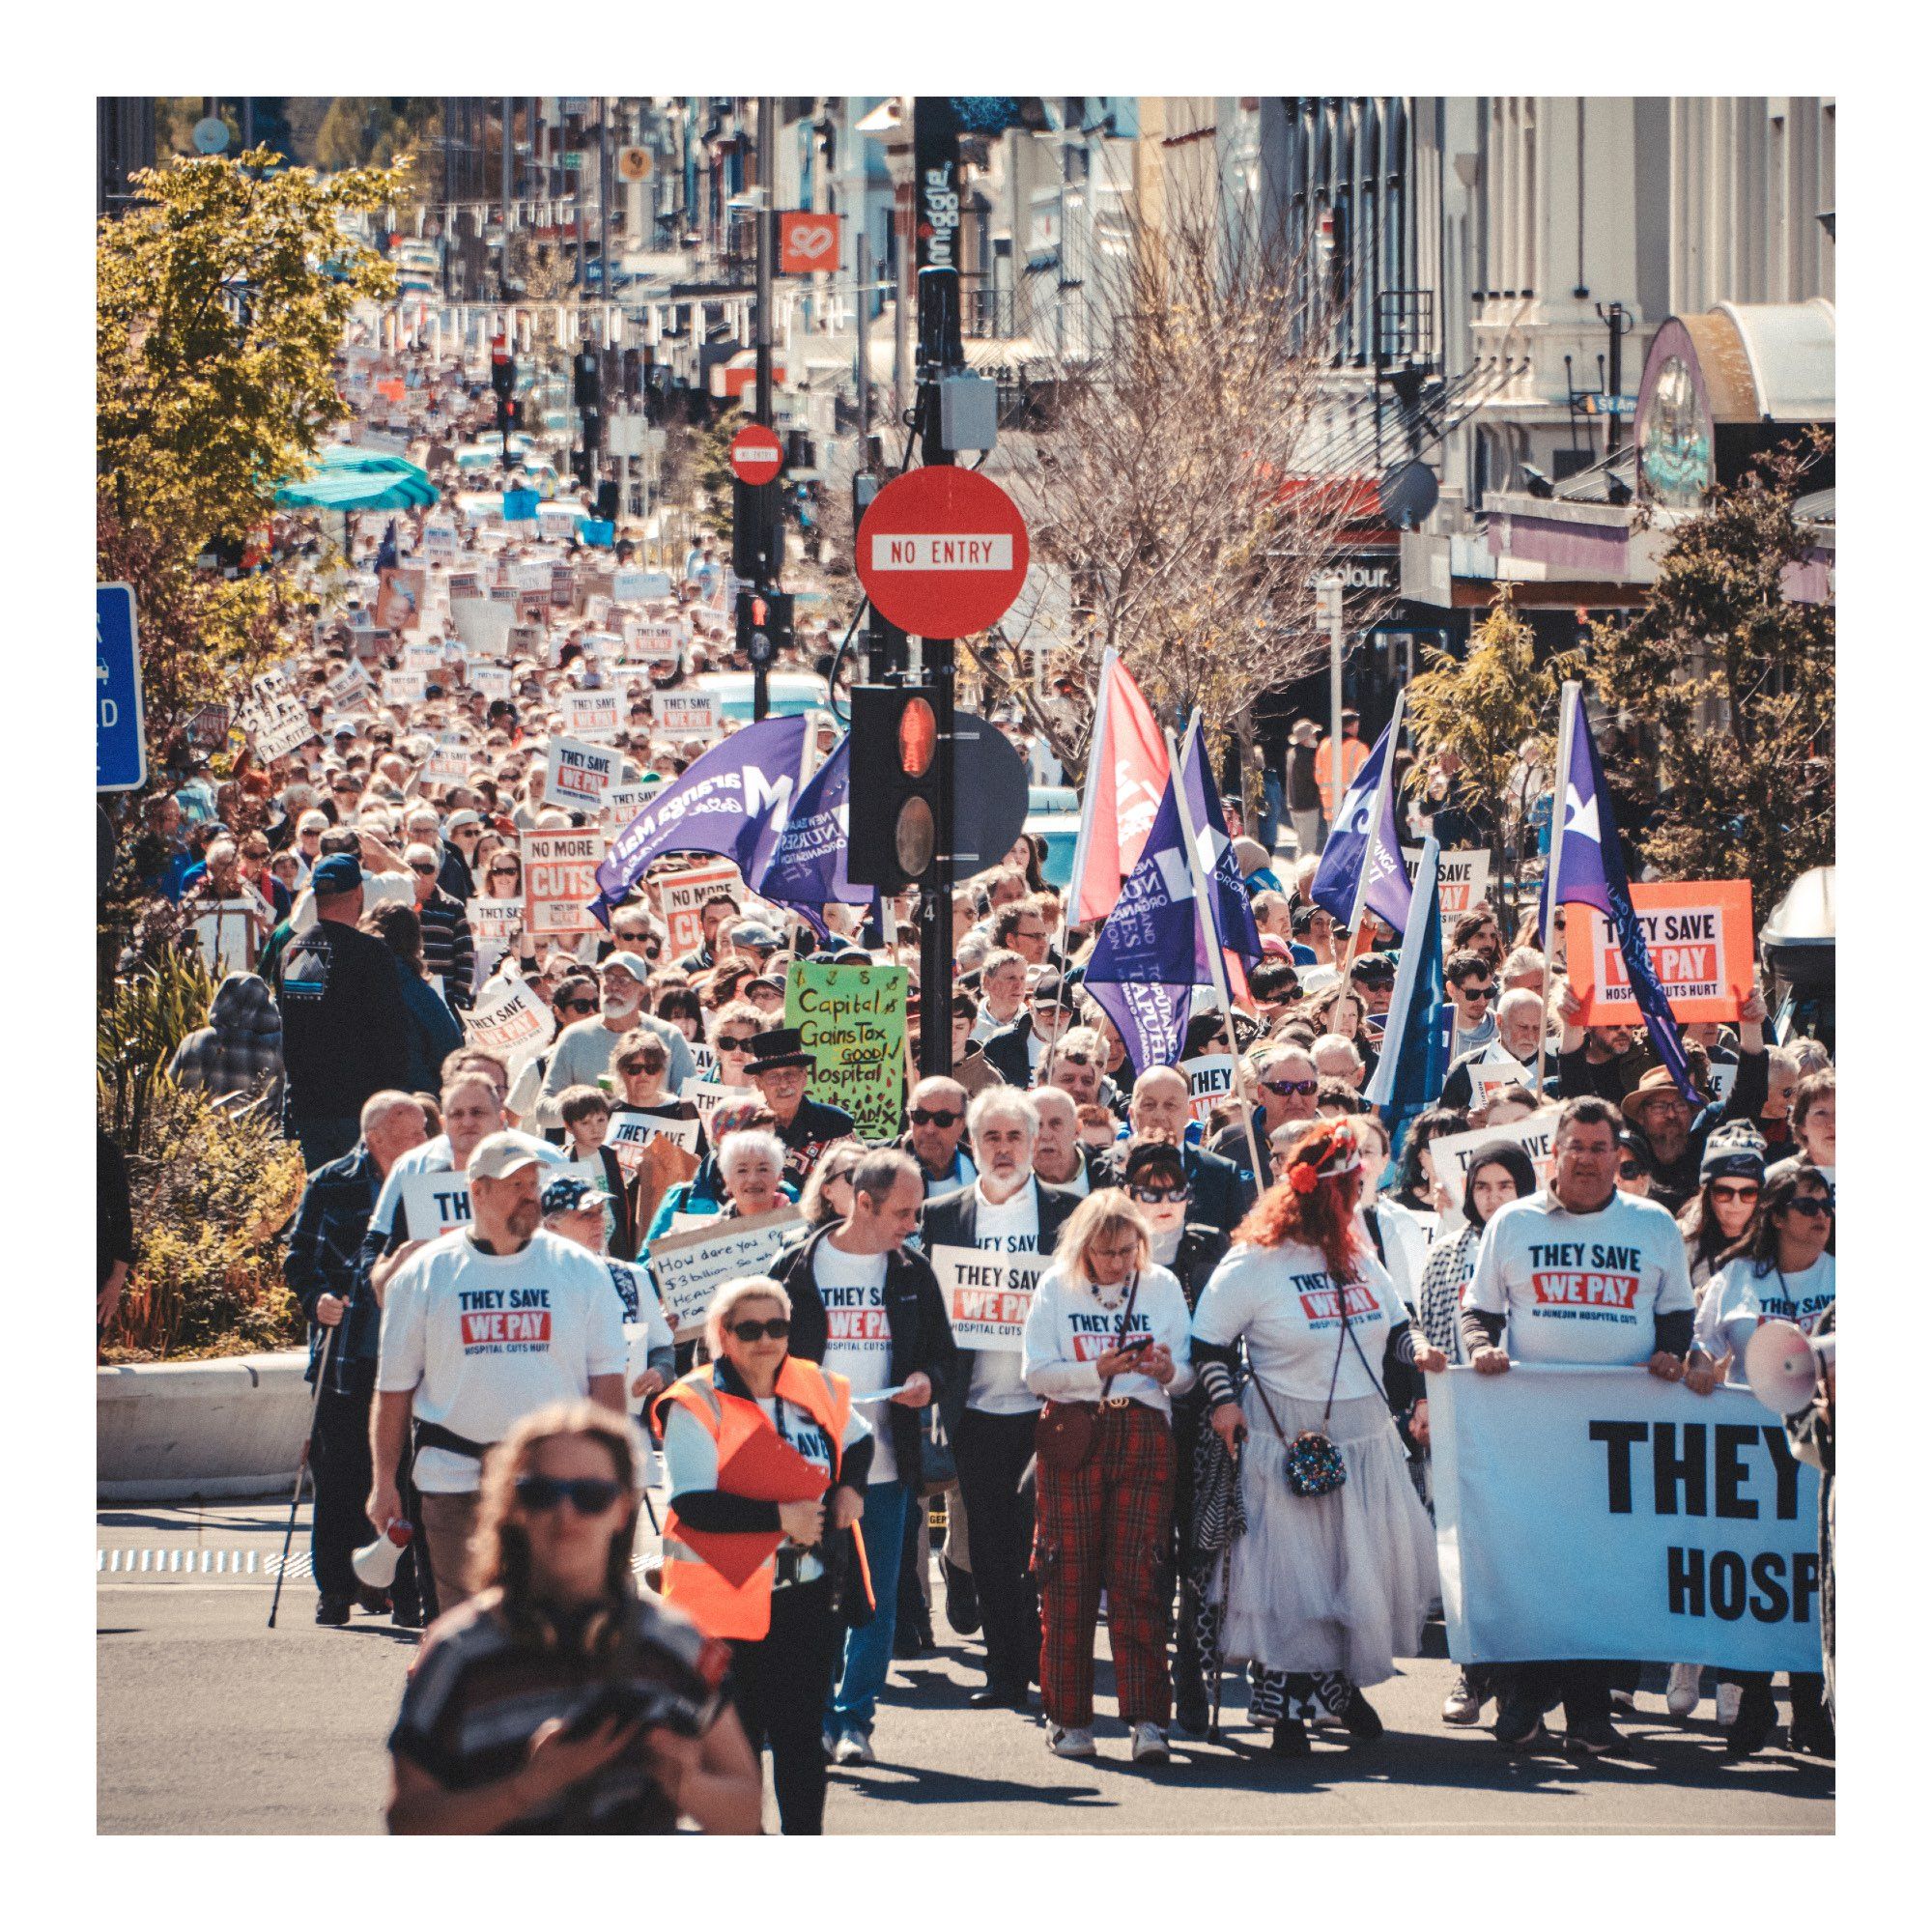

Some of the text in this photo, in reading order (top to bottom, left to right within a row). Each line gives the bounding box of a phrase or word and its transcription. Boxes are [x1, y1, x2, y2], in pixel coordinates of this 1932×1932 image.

[1599, 398, 1636, 412] St An
[891, 540, 993, 564] NO ENTRY
[573, 697, 616, 710] THEY SAVE
[664, 697, 711, 709] THEY SAVE
[560, 749, 611, 774] THEY SAVE
[563, 767, 584, 787] WE
[612, 793, 635, 805] THEY
[532, 839, 593, 858] NO MORE
[533, 866, 596, 896] CUTS
[1437, 864, 1472, 882] SAVE
[672, 891, 690, 906] NO
[480, 908, 519, 919] THEY SA
[1603, 914, 1716, 943] TEY SAVE
[1662, 947, 1708, 980] PAY
[1605, 983, 1718, 1000] HOSP UTS HURT
[467, 995, 526, 1030] THEY SAVE
[799, 987, 880, 1023] Capital
[800, 1020, 887, 1047] Gains Tax
[840, 1042, 888, 1062] GOOD!
[1190, 1068, 1233, 1096] THEY
[696, 1093, 723, 1110] TH
[616, 1123, 650, 1144] THEY
[1521, 1134, 1551, 1157] AVE
[433, 1190, 471, 1221] TH
[1007, 1235, 1038, 1253] SAV
[659, 1255, 694, 1274] How
[700, 1246, 733, 1261] dare
[737, 1238, 758, 1254] you
[1527, 1243, 1641, 1273] THEY SAVE
[954, 1264, 1041, 1290] THEY SAV
[1289, 1271, 1329, 1293] THEY
[459, 1288, 551, 1311] THEY SAVE
[821, 1288, 866, 1307] THEY
[1540, 1274, 1630, 1306] WE PAY
[961, 1292, 1031, 1323] WE PA
[1542, 1309, 1577, 1320] DUNEDIN
[1578, 1311, 1619, 1323] HOSPITAL
[468, 1313, 544, 1342] WE PAY
[829, 1311, 892, 1338] WE PA
[999, 1325, 1022, 1336] CUTS
[1067, 1313, 1151, 1333] THEY SVE
[465, 1343, 551, 1355] HOSPITAL CUTS HURT
[826, 1341, 886, 1351] OSPITAL CUTS
[1588, 1420, 1802, 1520] THEY
[928, 1515, 947, 1524] GER
[1666, 1546, 1820, 1623] HOSP
